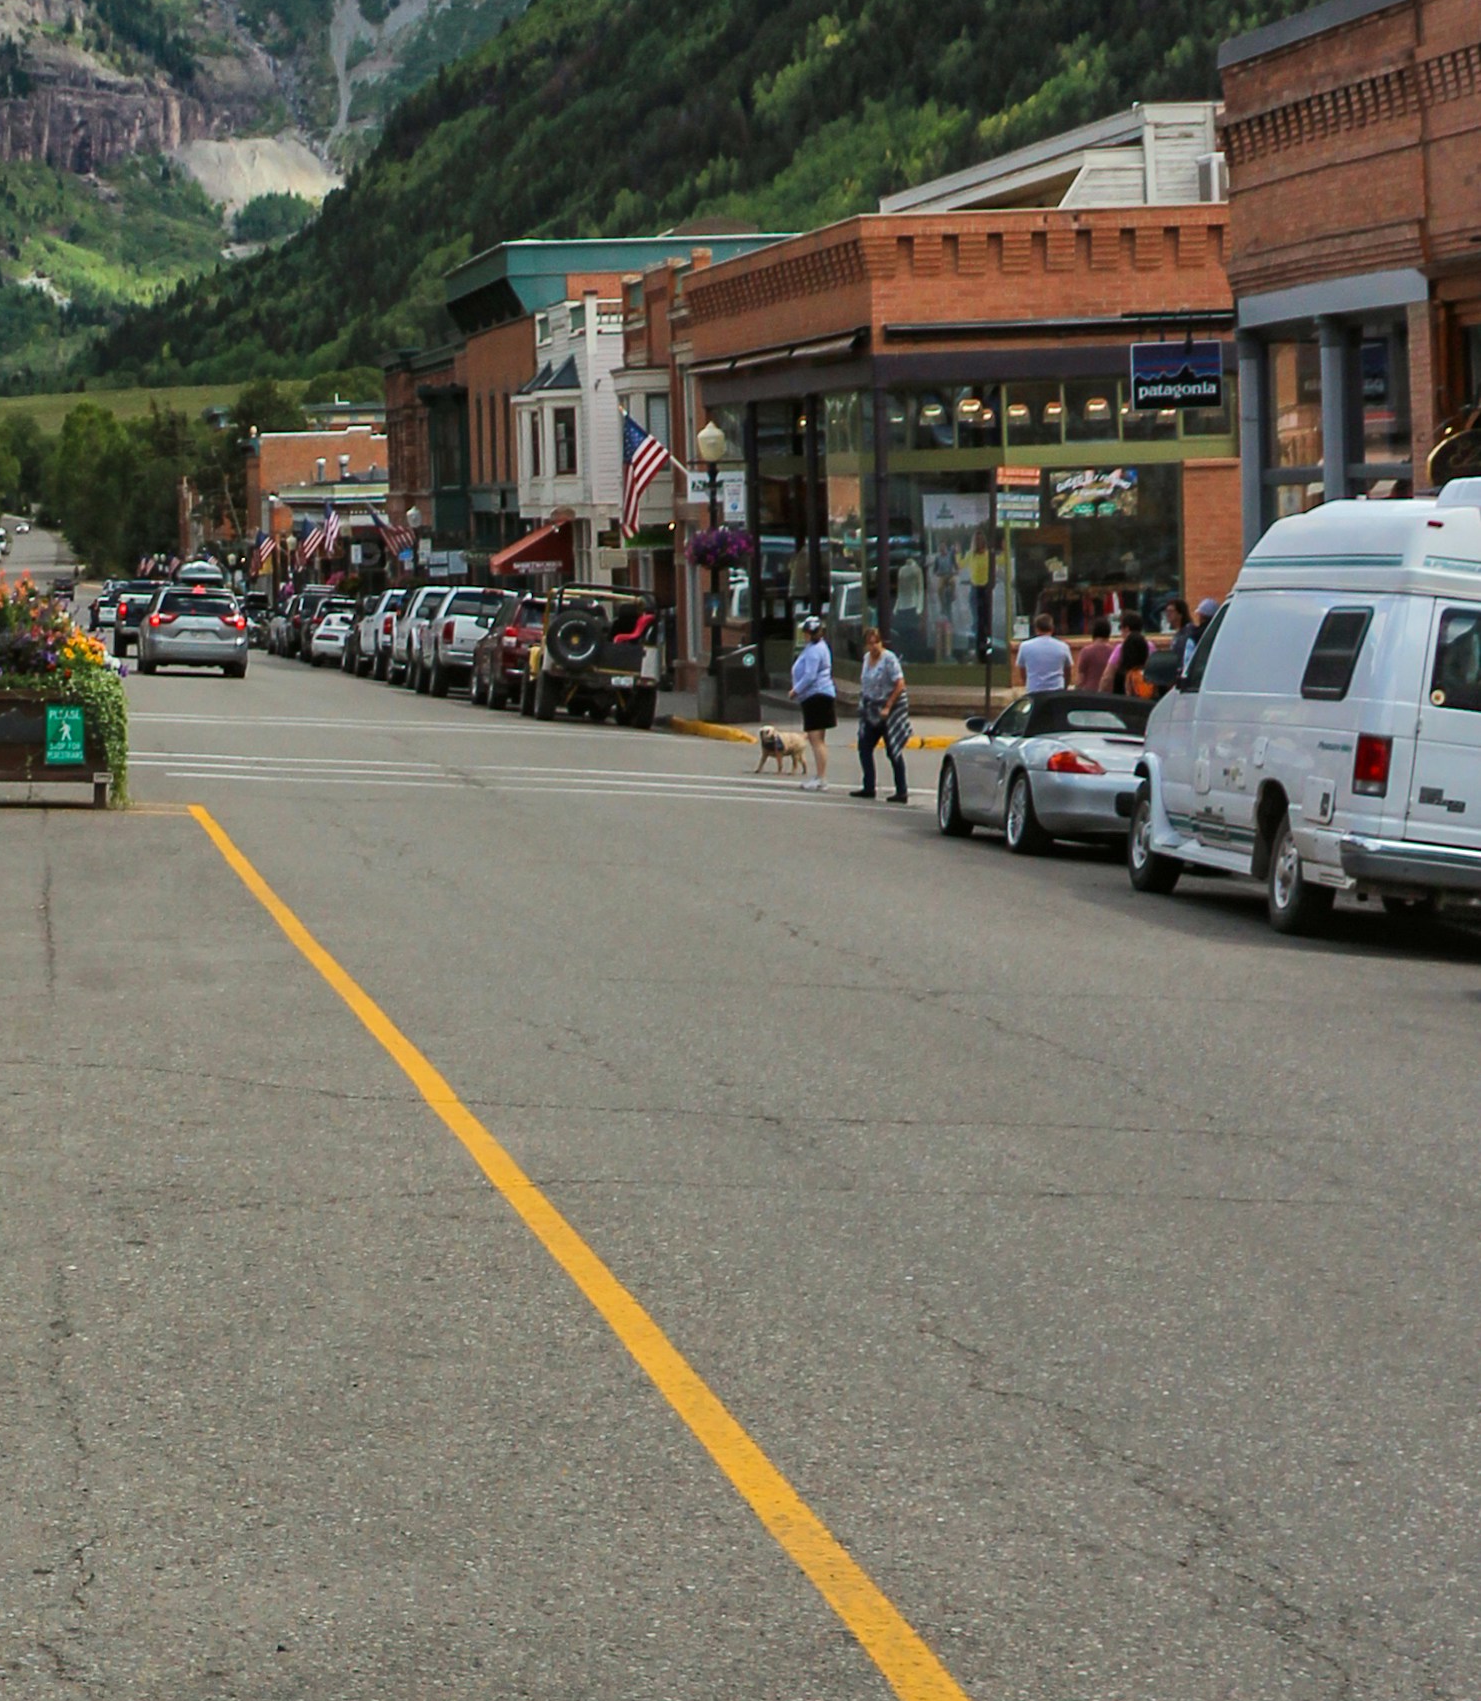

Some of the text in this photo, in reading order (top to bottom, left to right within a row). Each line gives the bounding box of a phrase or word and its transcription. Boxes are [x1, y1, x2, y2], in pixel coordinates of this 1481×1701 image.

[1138, 381, 1217, 400] patagonia
[48, 709, 81, 720] PLEASE
[50, 742, 66, 750] STOP
